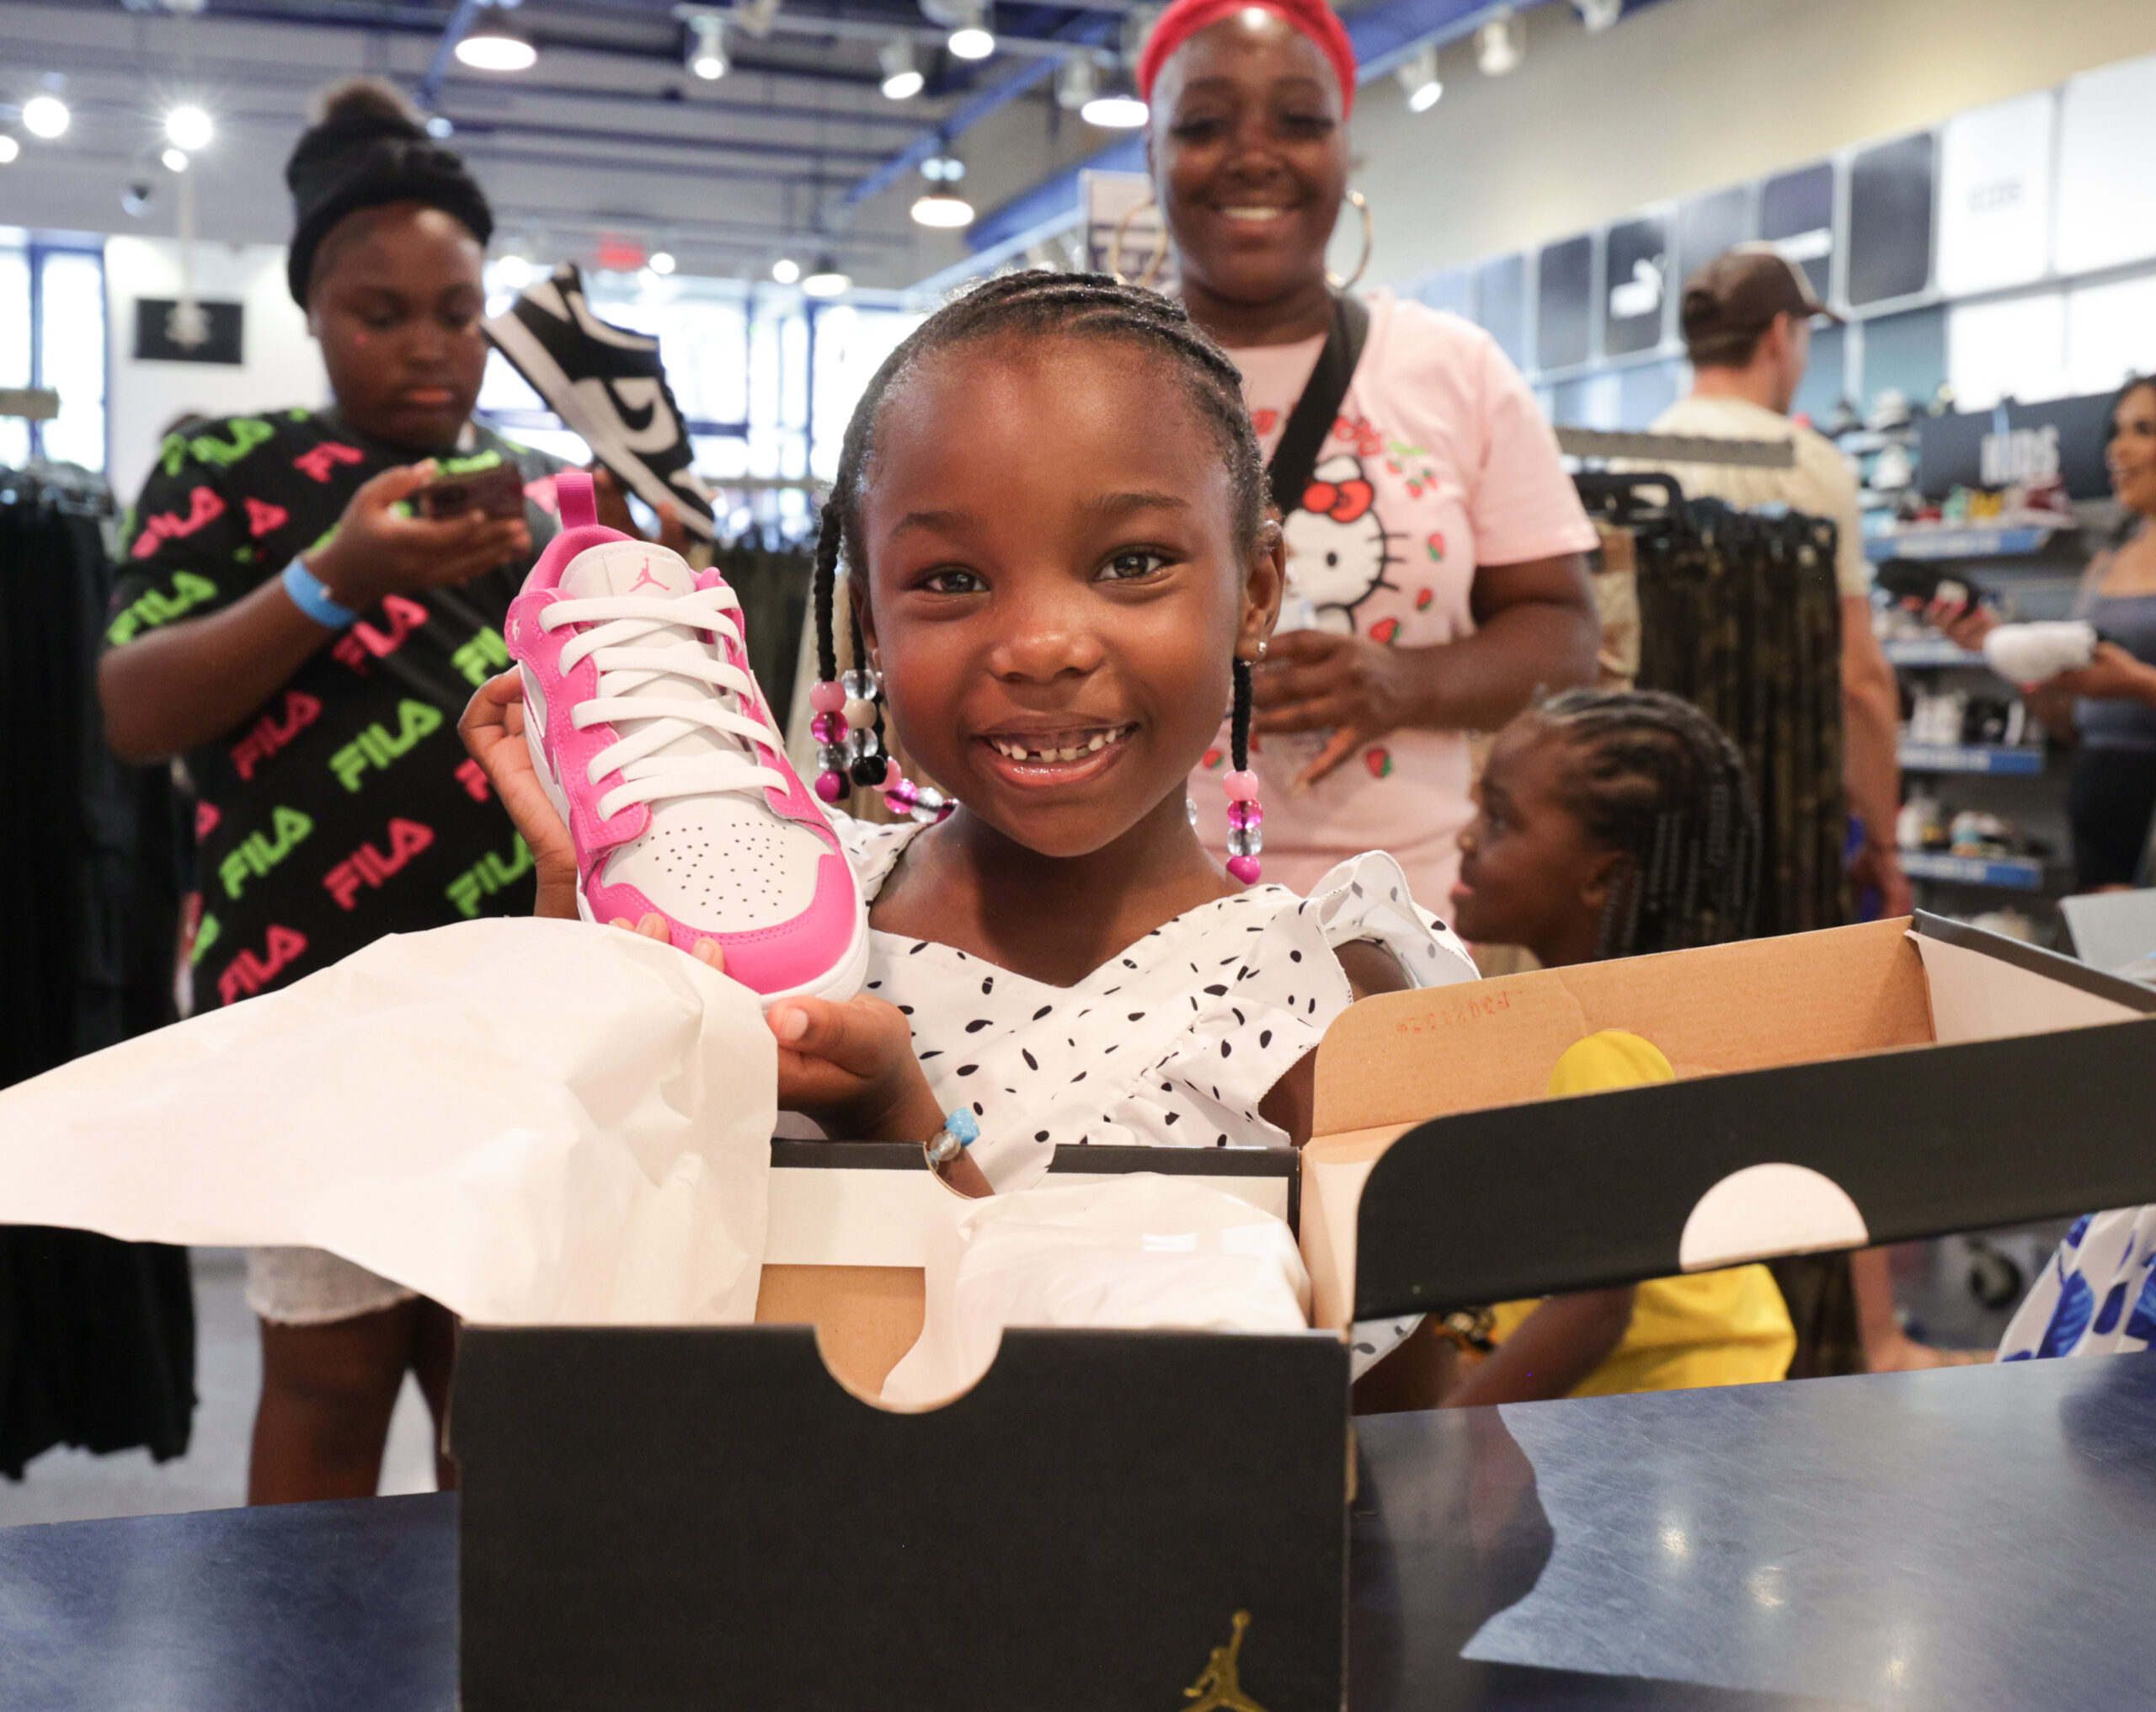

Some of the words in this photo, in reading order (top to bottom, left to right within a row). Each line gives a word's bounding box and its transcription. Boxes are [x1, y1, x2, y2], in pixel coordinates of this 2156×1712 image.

[231, 691, 322, 781] FILA
[329, 698, 443, 792] FILA
[219, 806, 313, 900] FILA
[323, 817, 435, 911] FILA
[446, 830, 534, 917] FIL
[217, 925, 308, 1006] FILA
